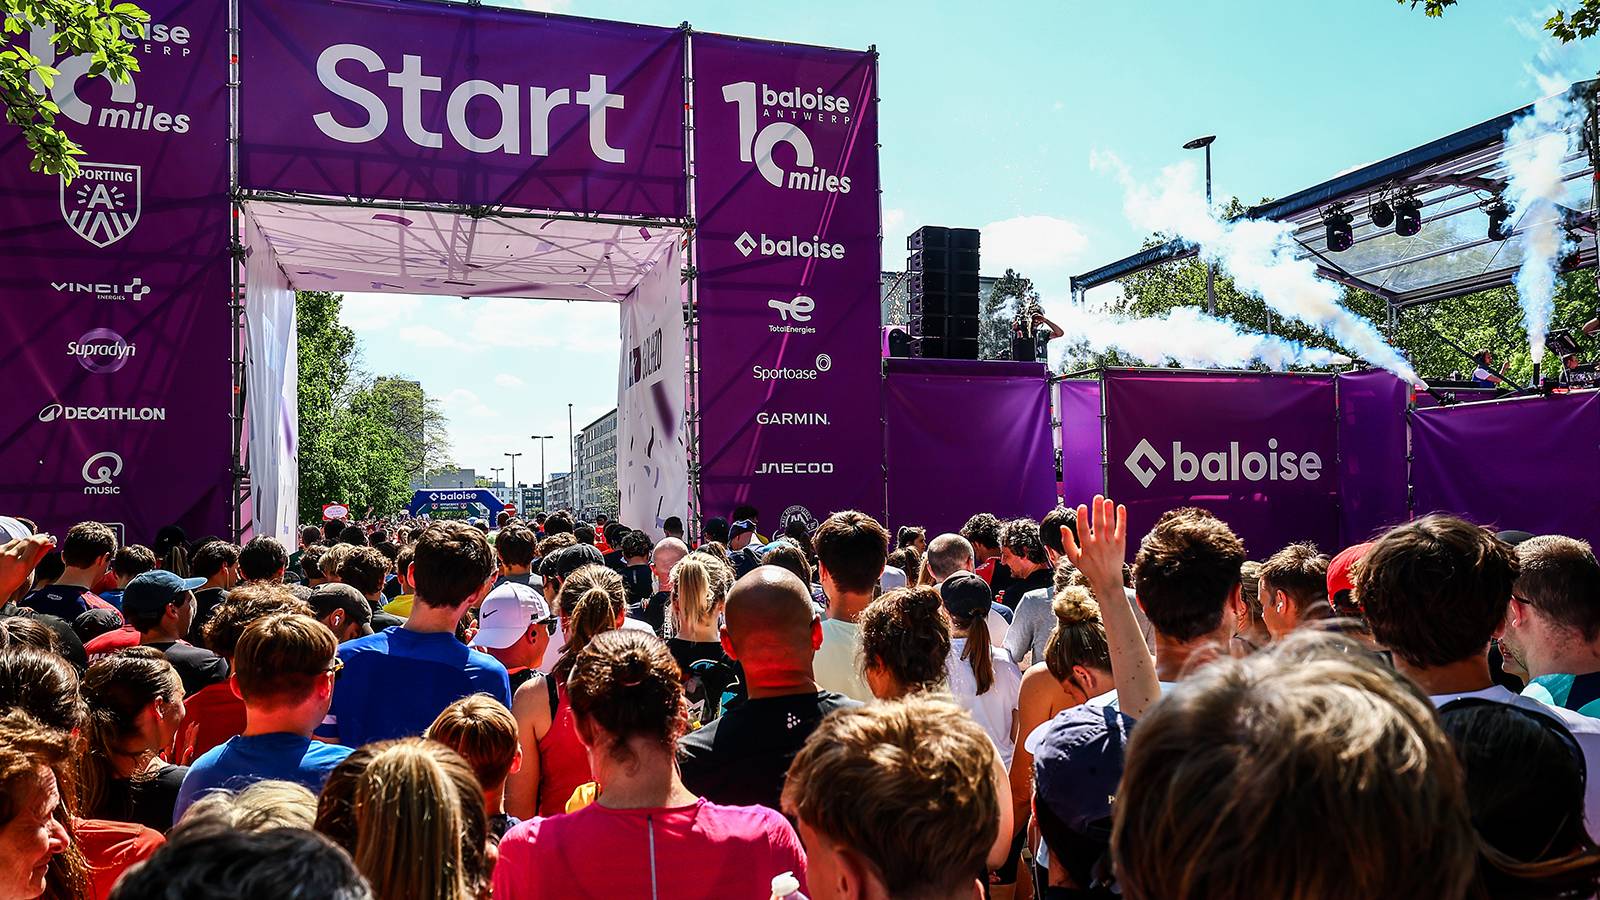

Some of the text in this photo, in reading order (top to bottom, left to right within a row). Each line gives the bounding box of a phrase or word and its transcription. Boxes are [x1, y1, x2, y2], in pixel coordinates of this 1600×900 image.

[313, 43, 626, 164] Start
[762, 83, 850, 114] baloise
[97, 102, 190, 134] miles
[763, 108, 851, 125] ANTWERP
[788, 166, 851, 194] miles
[760, 233, 846, 260] baloise
[51, 281, 118, 294] VINCI
[769, 324, 816, 335] TotalEnergies
[753, 365, 818, 382] Sportoase
[64, 406, 166, 421] DECATHLON
[1172, 438, 1322, 482] baloise
[439, 490, 478, 501] baloise
